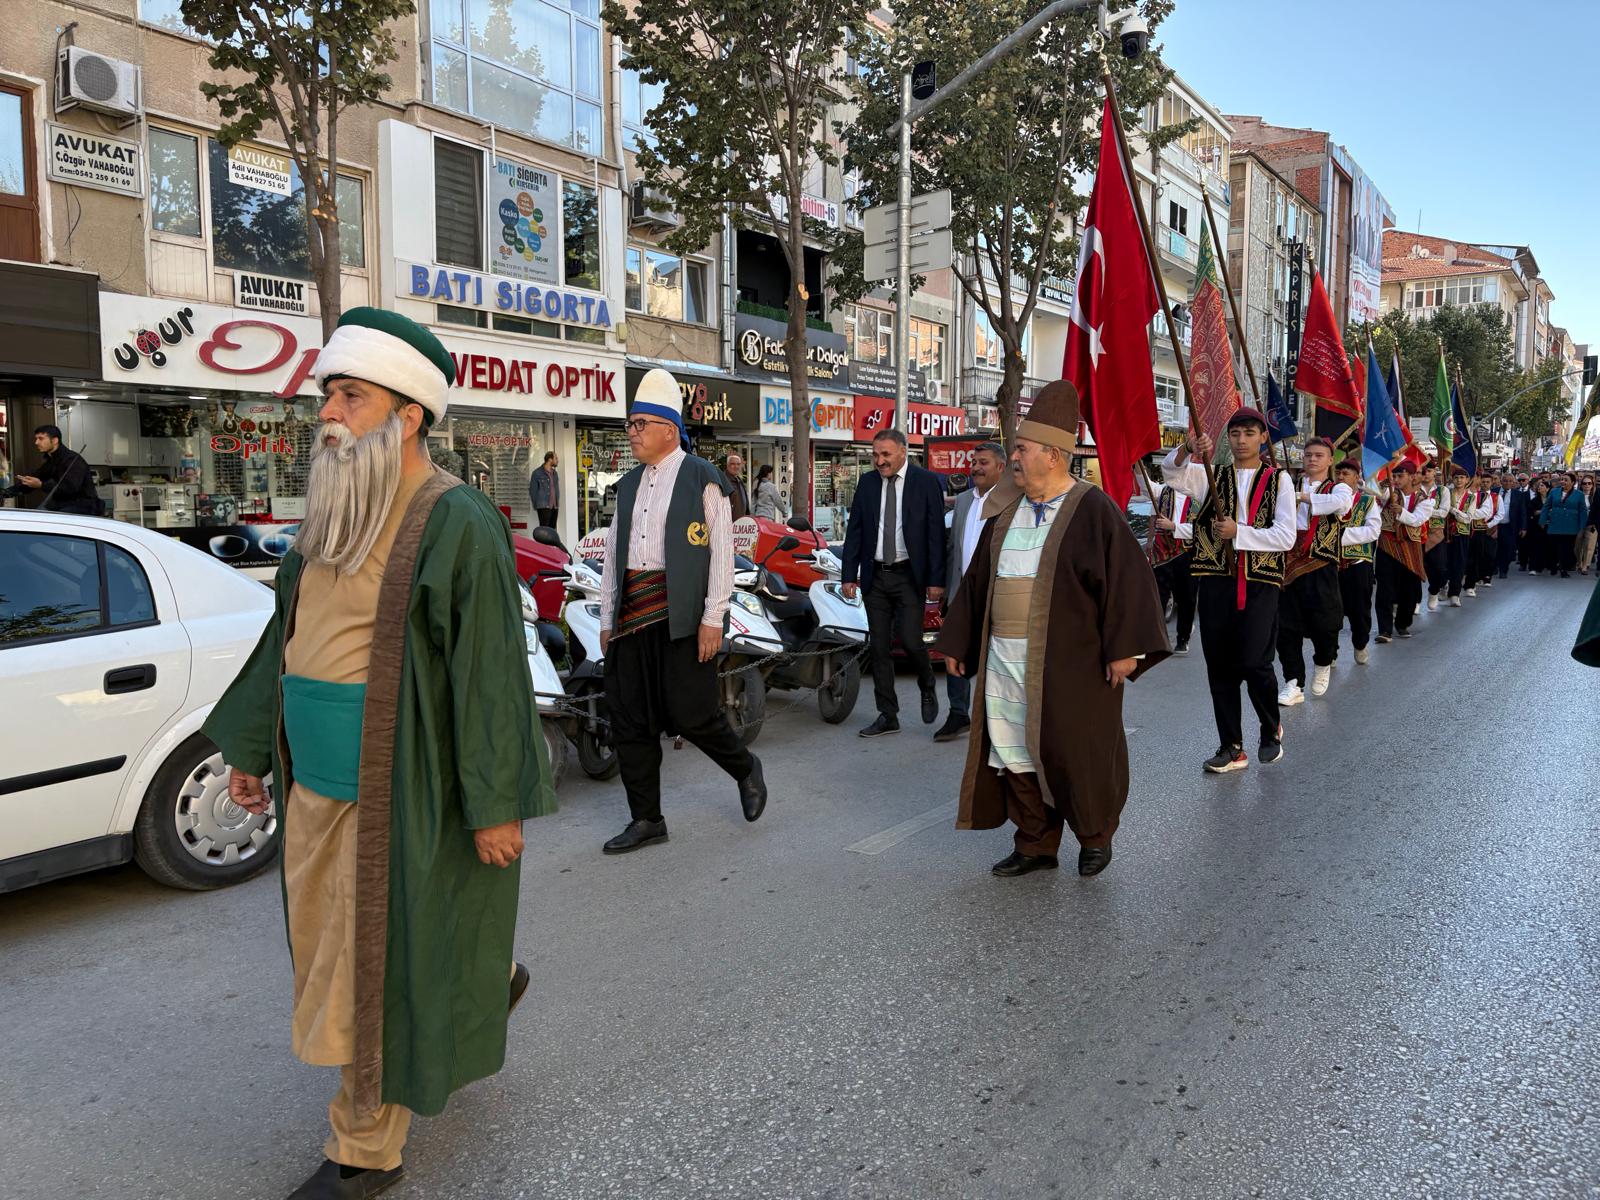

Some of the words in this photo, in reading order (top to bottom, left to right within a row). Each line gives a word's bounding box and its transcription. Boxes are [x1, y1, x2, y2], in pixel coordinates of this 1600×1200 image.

[55, 133, 136, 163] AVUKAT
[88, 158, 134, 176] VAHABOĞLU
[235, 148, 284, 171] AVUKAT
[111, 176, 119, 184] 61
[247, 167, 288, 183] VAHABOĞLU
[255, 177, 266, 185] 927
[240, 275, 303, 300] AVUKAT
[410, 265, 482, 305] BATI
[259, 298, 304, 312] VAHABOĞLU
[450, 352, 537, 394] VEDAT
[468, 434, 500, 446] VEDAT
